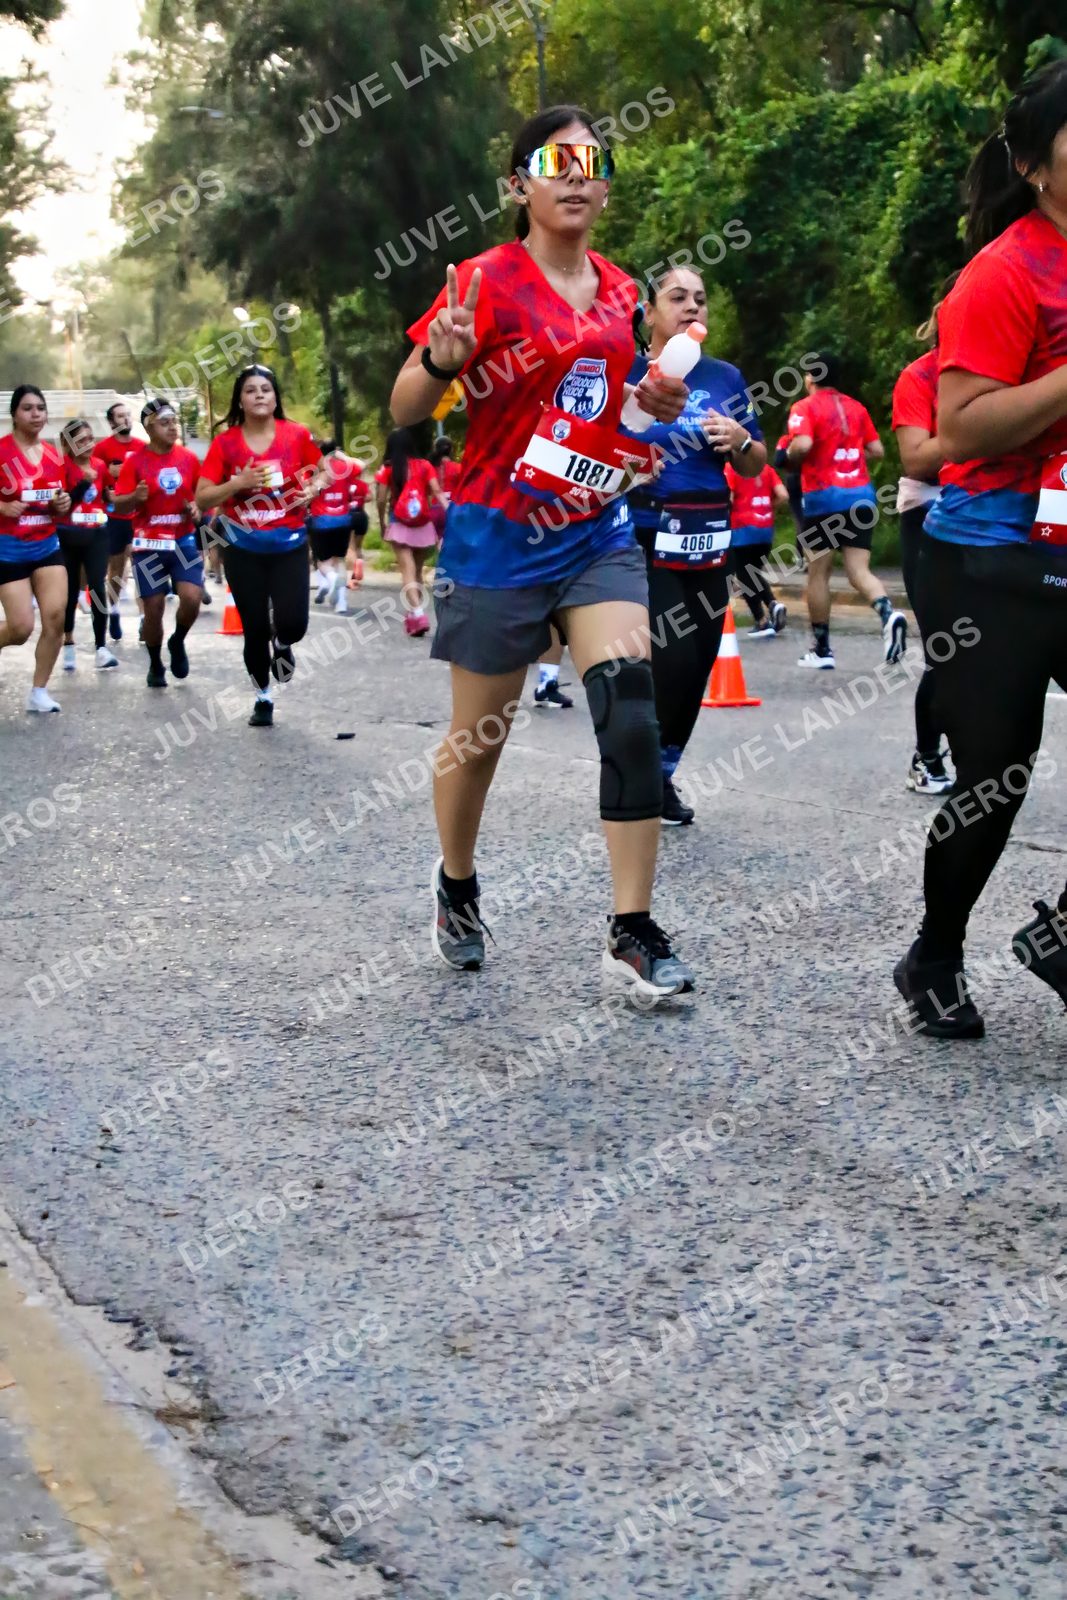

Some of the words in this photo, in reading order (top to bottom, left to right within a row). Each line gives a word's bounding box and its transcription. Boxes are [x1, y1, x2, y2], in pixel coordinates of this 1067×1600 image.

[571, 376, 596, 388] Global
[562, 386, 584, 398] Race
[565, 454, 614, 490] 1881
[680, 534, 714, 552] 4060
